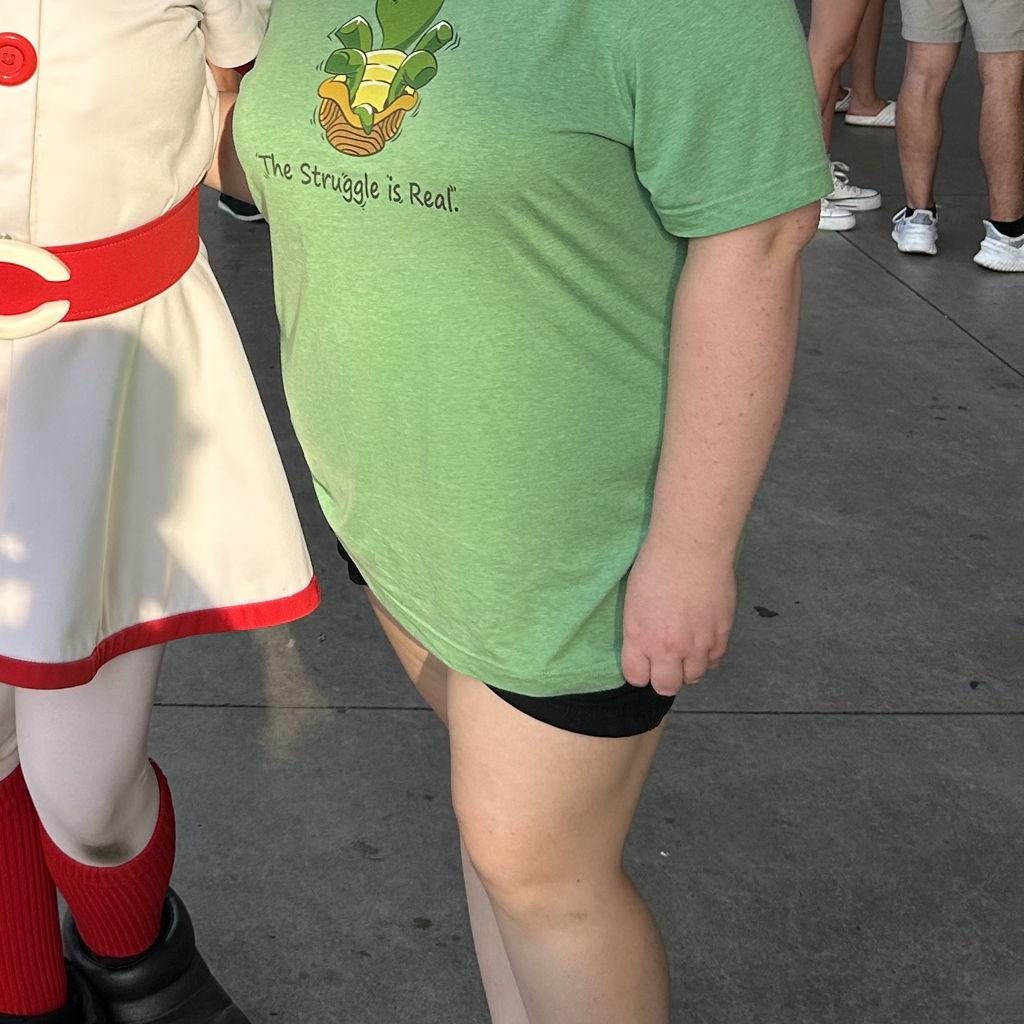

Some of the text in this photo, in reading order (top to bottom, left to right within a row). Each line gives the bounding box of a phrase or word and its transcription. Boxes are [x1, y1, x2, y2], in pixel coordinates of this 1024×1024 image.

[258, 153, 292, 180] The
[300, 162, 380, 206] Struggle
[387, 176, 403, 203] is
